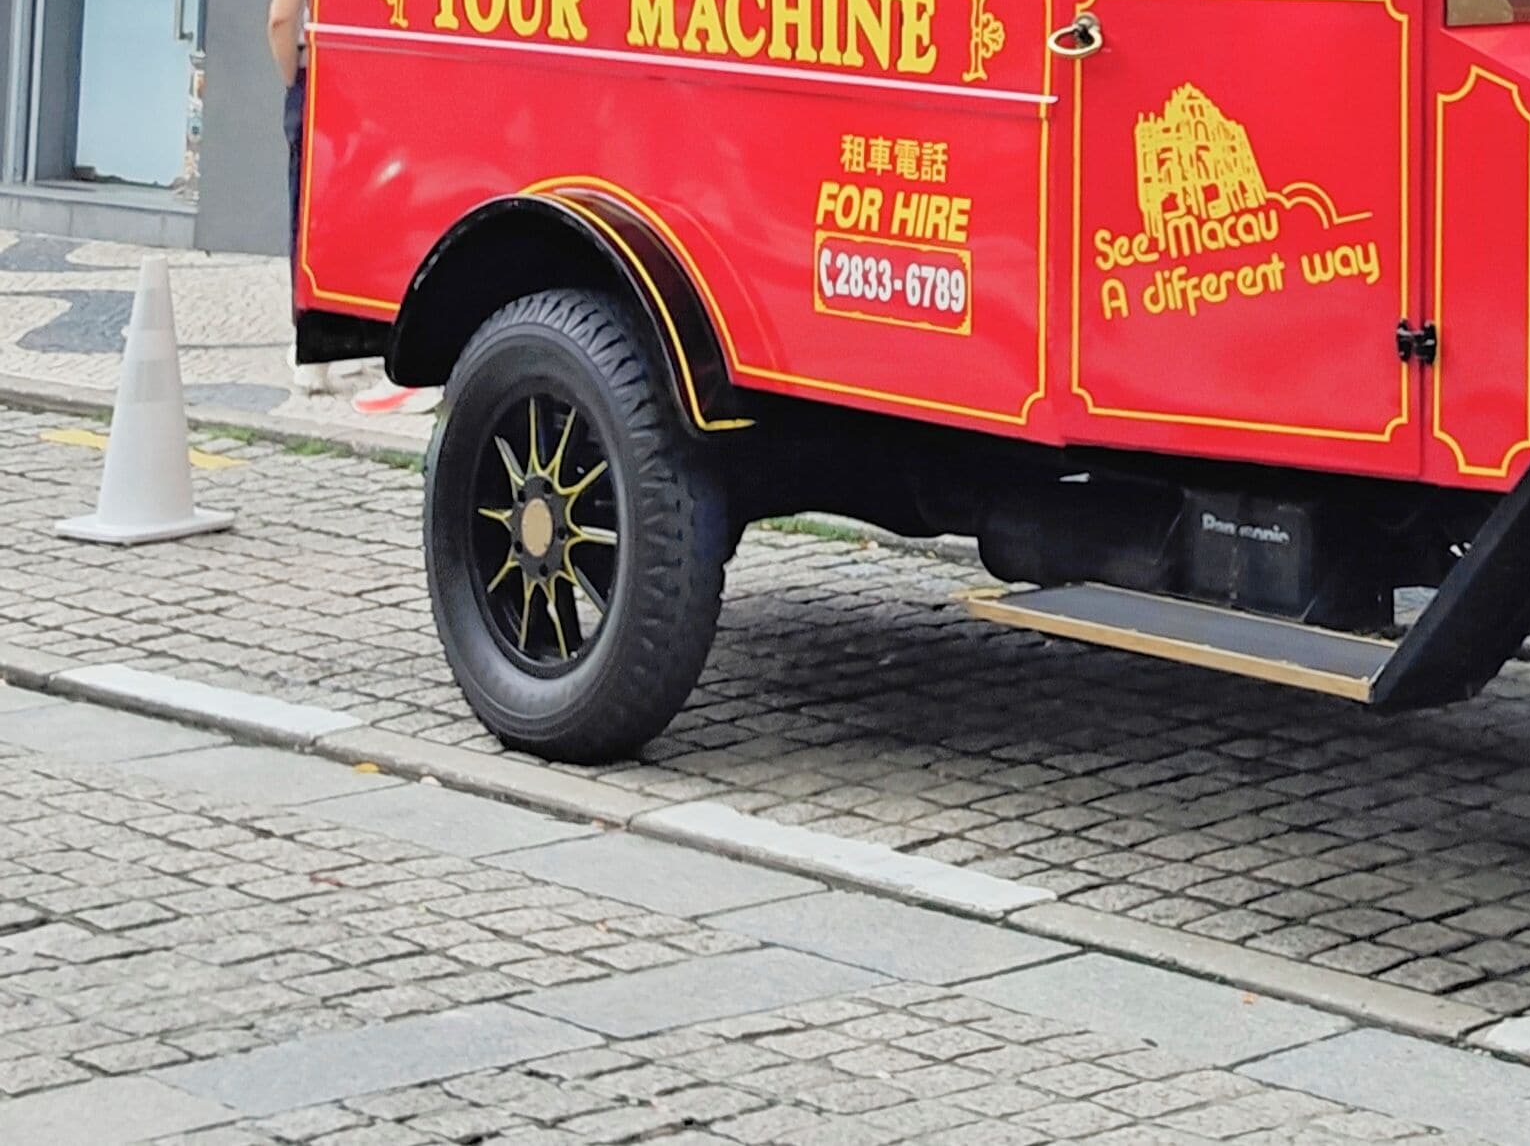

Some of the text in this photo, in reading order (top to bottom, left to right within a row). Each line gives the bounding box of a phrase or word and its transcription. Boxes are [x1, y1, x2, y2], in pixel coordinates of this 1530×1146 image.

[840, 134, 948, 183] 租車電話
[816, 182, 972, 243] FOR HIRE
[1095, 208, 1279, 271] See Macau
[834, 249, 965, 315] 2833-6789
[1101, 241, 1380, 320] A different way
